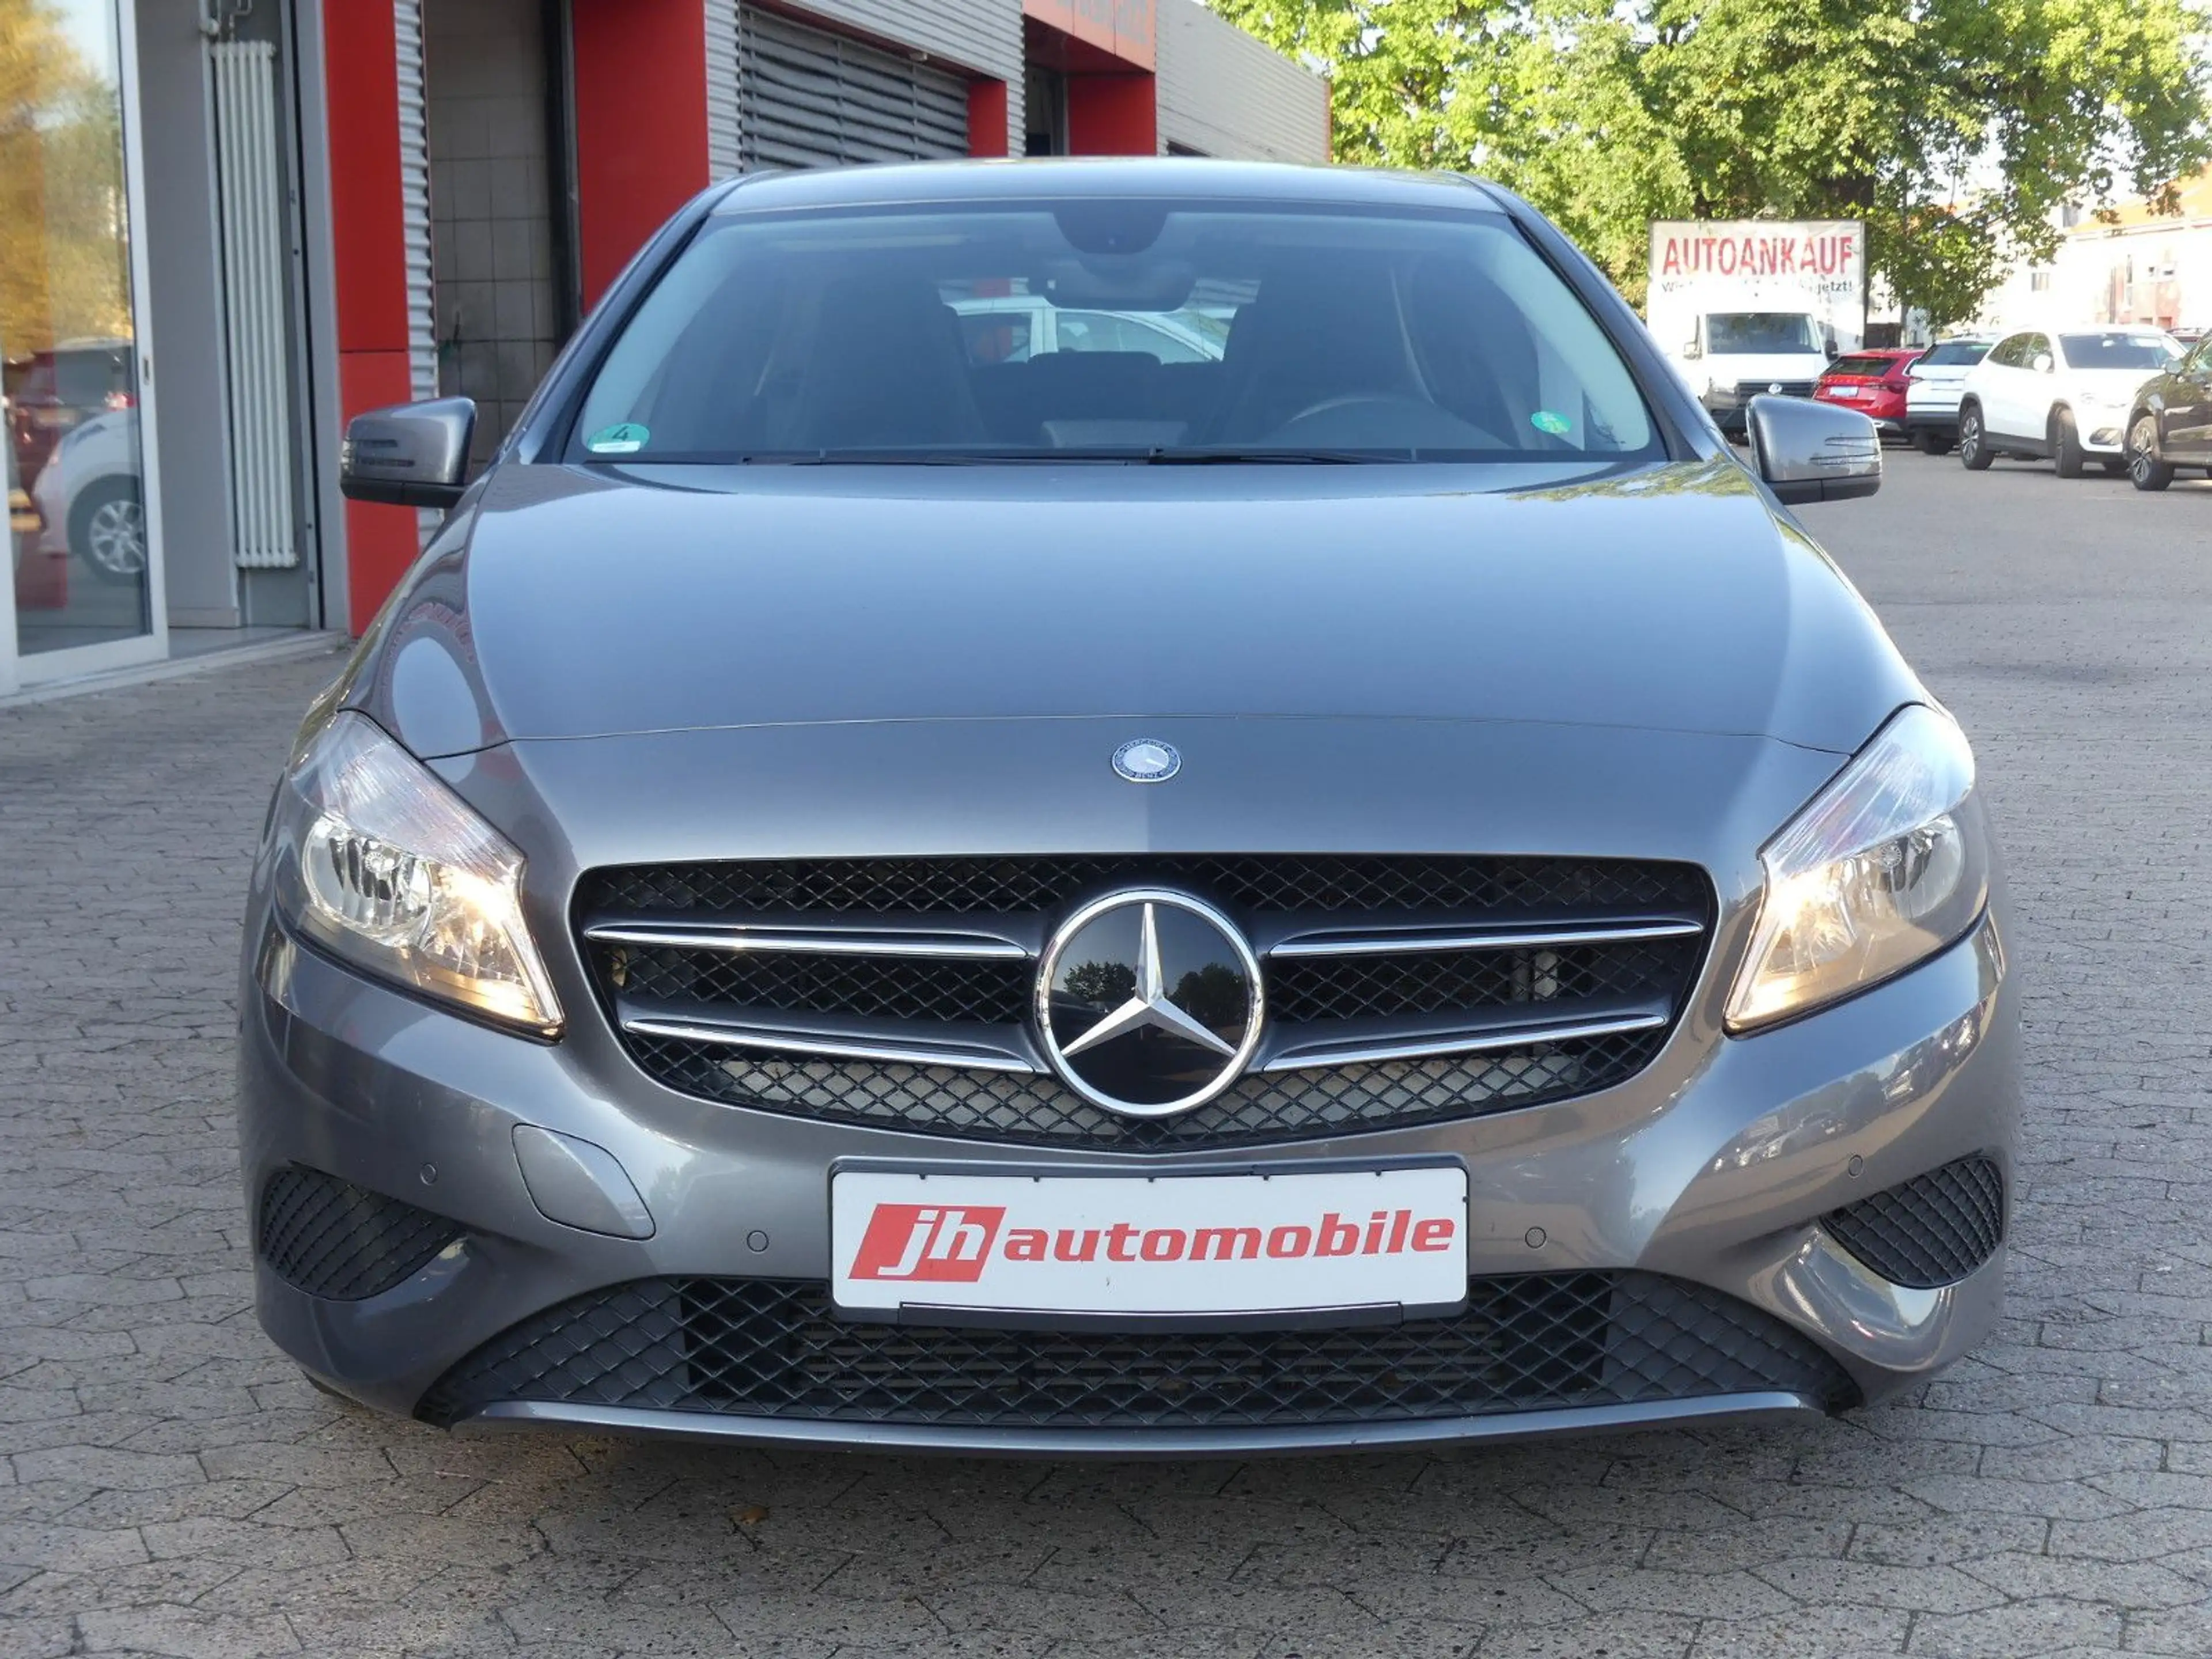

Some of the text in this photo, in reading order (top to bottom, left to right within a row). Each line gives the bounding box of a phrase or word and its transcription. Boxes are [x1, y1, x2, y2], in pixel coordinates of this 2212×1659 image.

[1663, 237, 1853, 275] AUTOANKAUF
[1817, 281, 1852, 294] jetzt!
[1003, 1209, 1455, 1262] automobile
